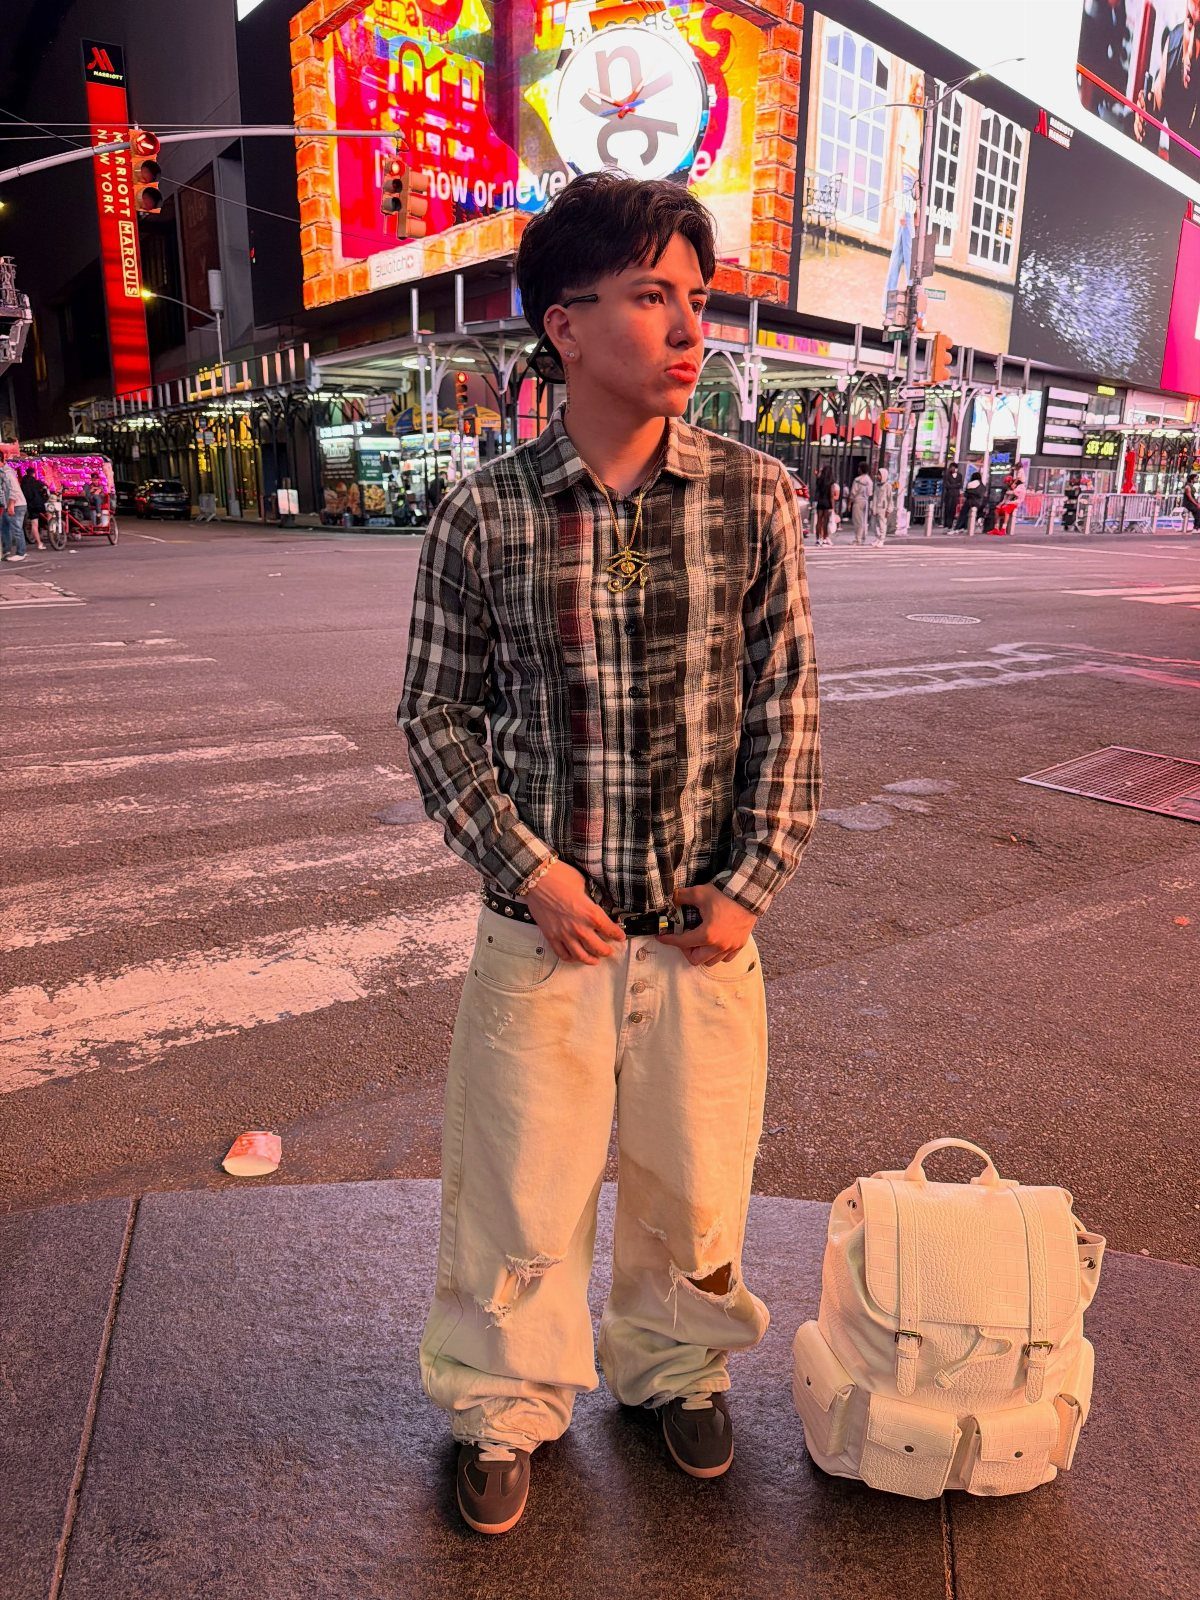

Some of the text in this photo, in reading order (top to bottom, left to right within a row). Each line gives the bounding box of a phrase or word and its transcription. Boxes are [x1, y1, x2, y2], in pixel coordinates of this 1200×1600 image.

[97, 129, 115, 213] NW YORK
[113, 131, 138, 295] MRRIOTT MARQUIS
[473, 178, 496, 208] or
[502, 170, 567, 208] neve
